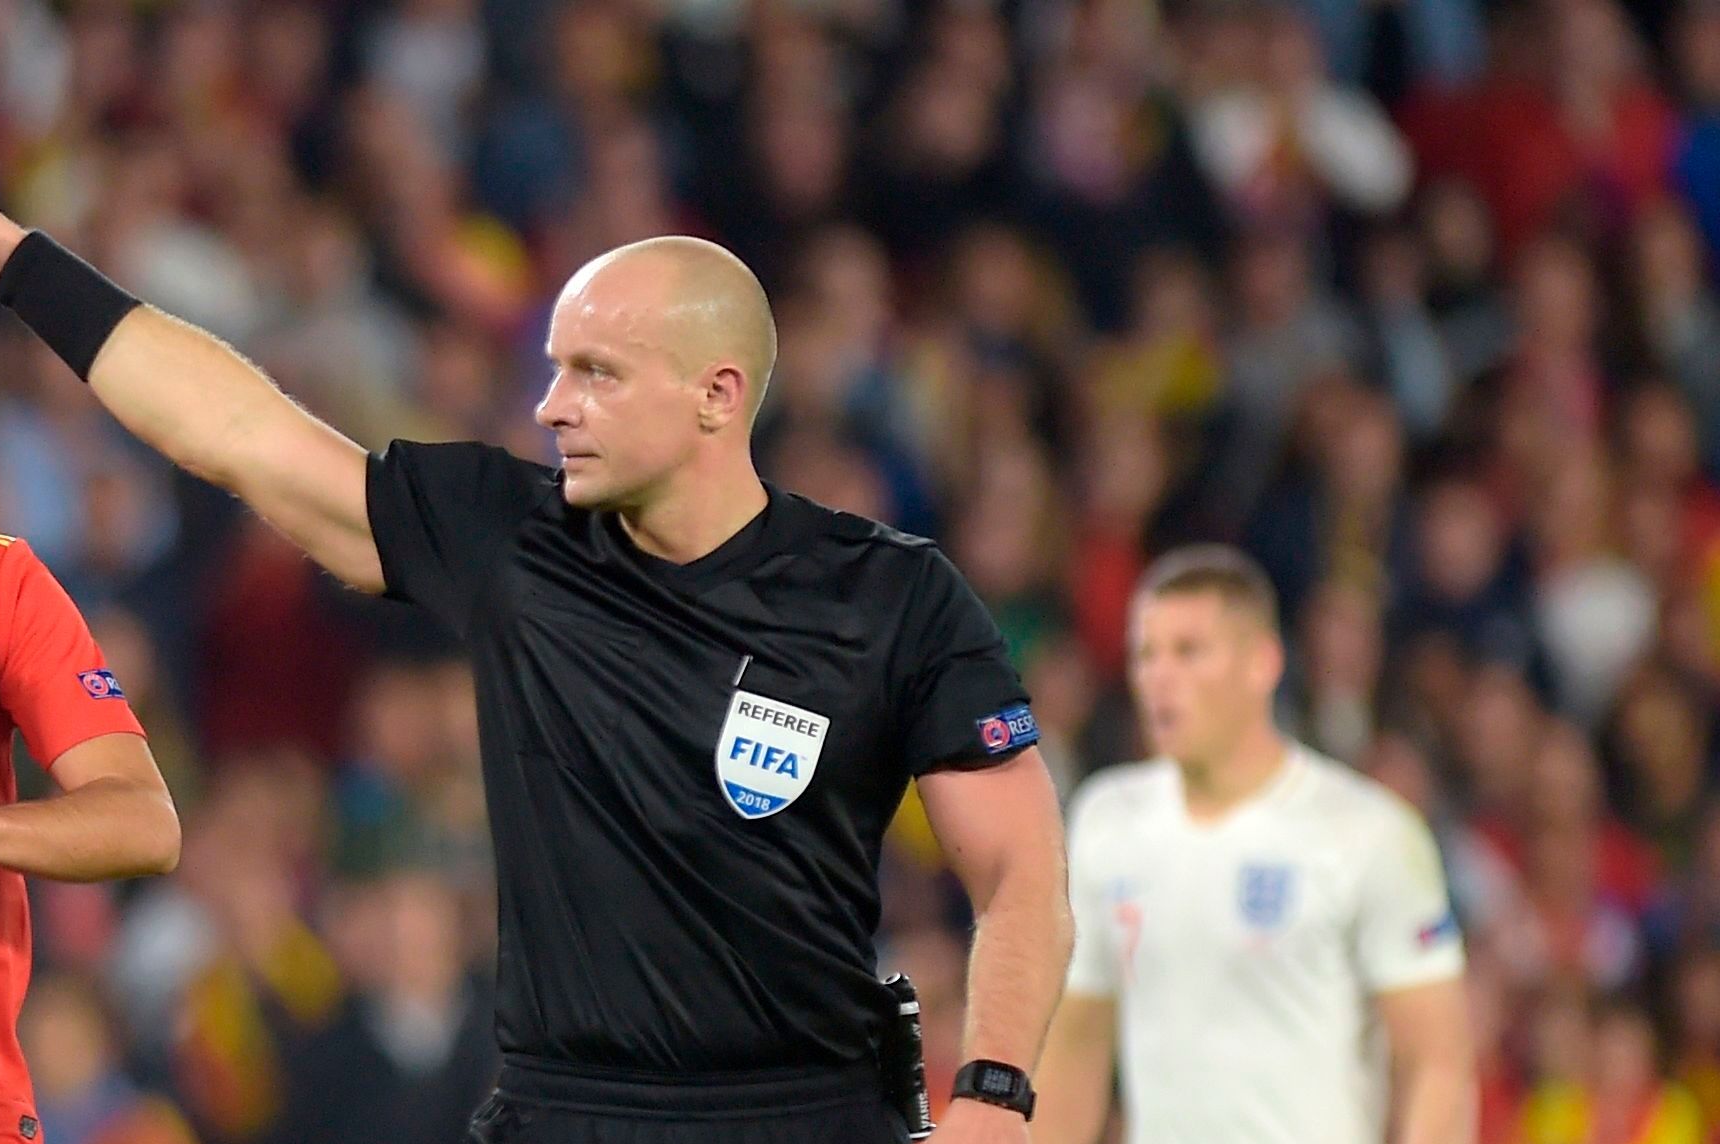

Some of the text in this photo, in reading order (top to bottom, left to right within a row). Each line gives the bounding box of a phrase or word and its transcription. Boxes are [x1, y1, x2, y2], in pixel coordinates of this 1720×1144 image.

[738, 701, 821, 738] REFEREE
[729, 736, 799, 780] FIFA
[736, 791, 771, 811] 2018
